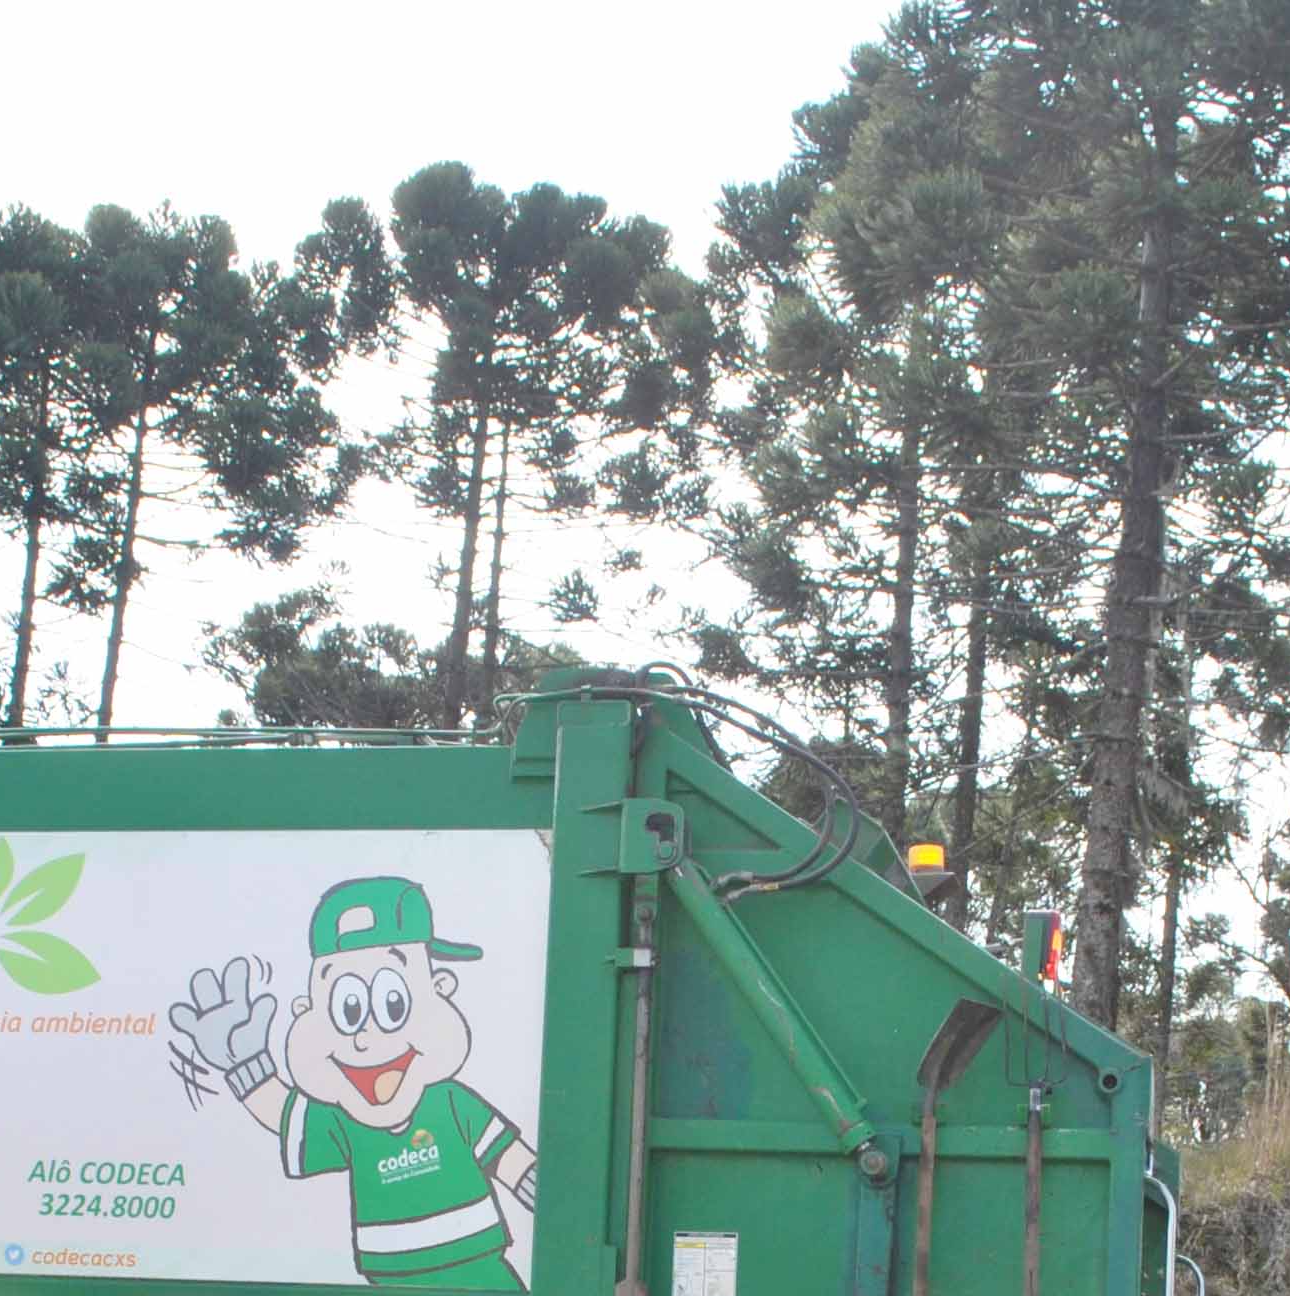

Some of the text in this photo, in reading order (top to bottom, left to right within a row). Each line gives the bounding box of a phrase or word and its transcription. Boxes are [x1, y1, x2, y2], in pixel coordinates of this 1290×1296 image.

[31, 1012, 156, 1035] ambiental
[378, 1145, 438, 1172] codeca
[28, 1159, 186, 1186] Alô CODECA
[38, 1193, 175, 1218] 3224.8000
[31, 1247, 137, 1267] codecacxs
